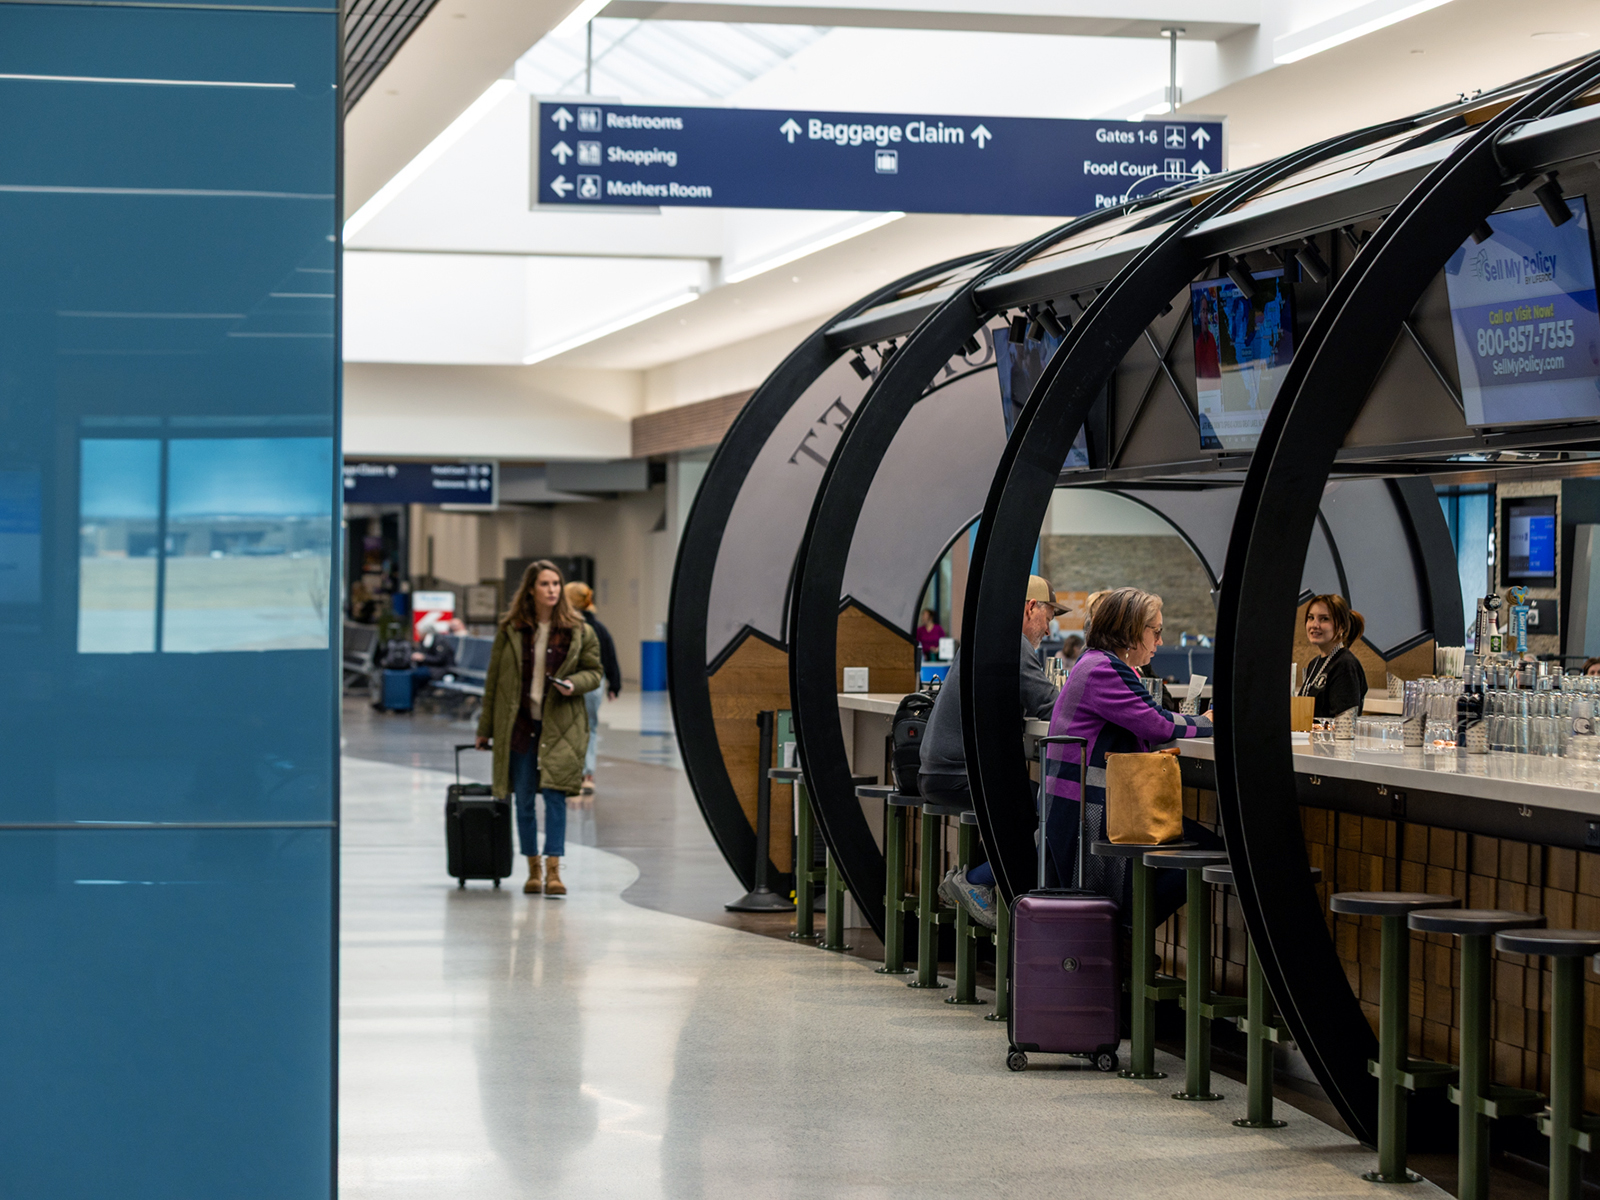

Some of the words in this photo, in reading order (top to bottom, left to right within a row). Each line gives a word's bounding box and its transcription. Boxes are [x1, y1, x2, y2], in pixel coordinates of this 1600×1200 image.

[607, 112, 684, 130] Restrooms
[808, 118, 902, 147] Baggage
[905, 121, 964, 144] Claim
[1095, 128, 1135, 144] Gates
[1137, 129, 1158, 144] 1-6
[607, 146, 678, 167] Shopping
[1083, 160, 1118, 176] Food
[1119, 161, 1158, 176] Court
[607, 180, 668, 197] Mothers
[669, 182, 712, 198] Room
[1095, 193, 1118, 208] Pet
[1484, 259, 1504, 282] Sell
[1505, 257, 1522, 284] My
[1523, 250, 1557, 278] Policy
[1489, 309, 1504, 325] Call
[1505, 312, 1514, 324] or
[1514, 305, 1532, 322] Visit
[1534, 303, 1555, 319] Now!
[1477, 319, 1575, 357] 800-857-7355
[1493, 354, 1565, 377] SellMyPolicy.com
